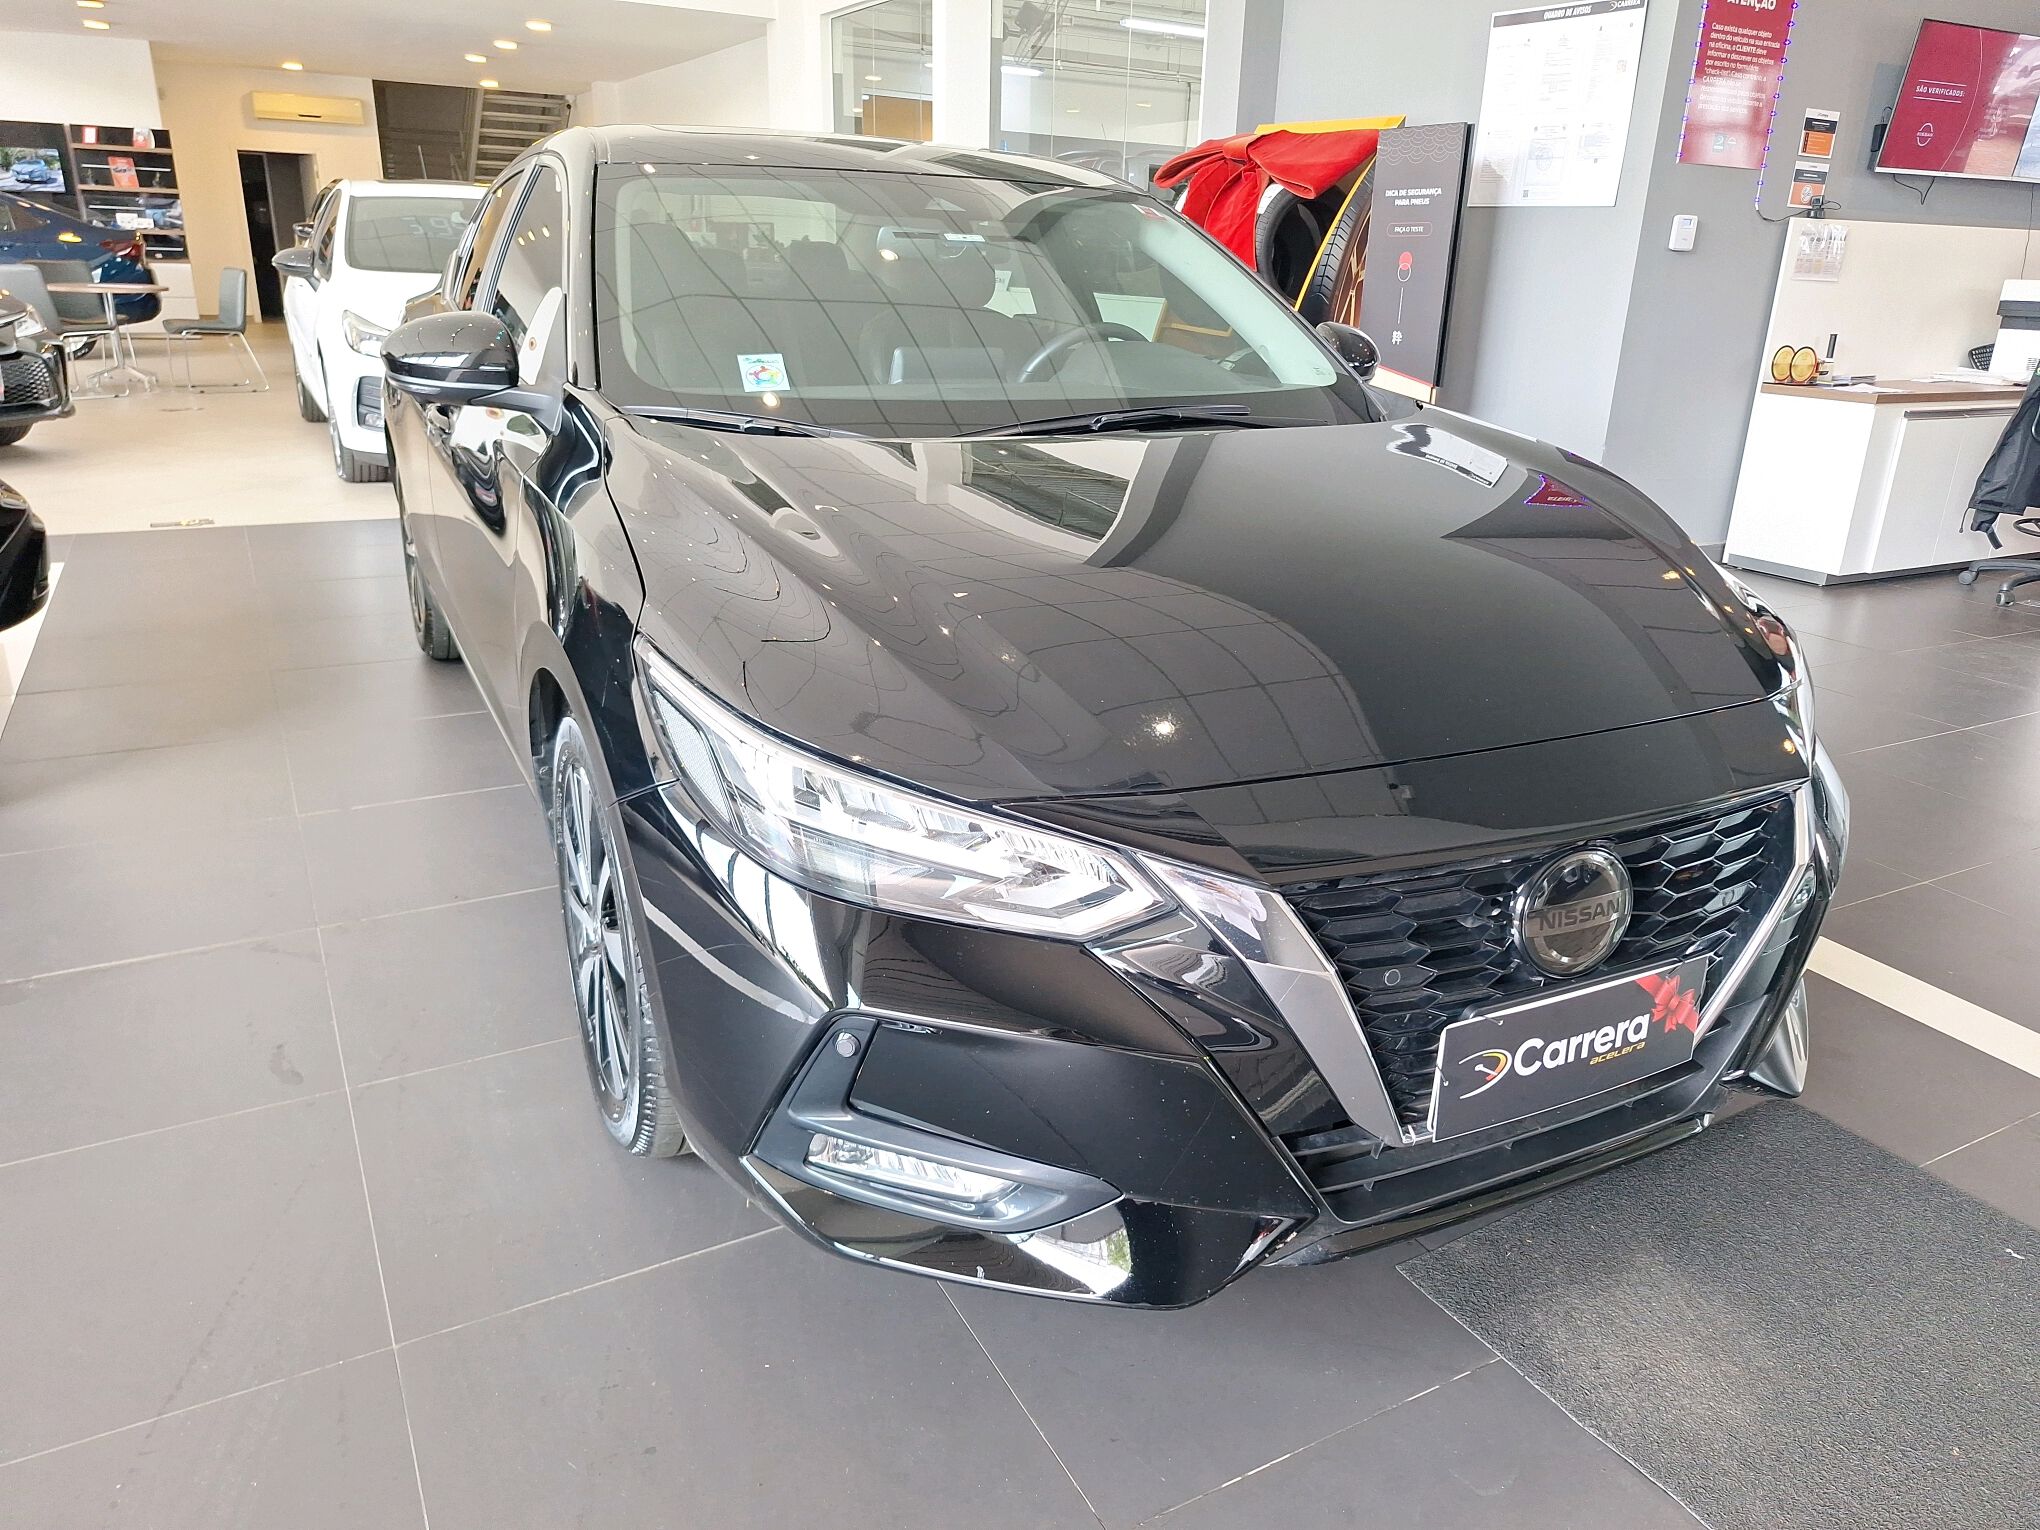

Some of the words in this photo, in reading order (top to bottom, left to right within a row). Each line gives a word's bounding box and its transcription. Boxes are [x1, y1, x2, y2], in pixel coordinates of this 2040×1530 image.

[1727, 0, 1776, 11] ENÇÃO
[1738, 27, 1758, 37] qualquer
[1758, 30, 1772, 39] objeto
[1736, 44, 1756, 53] CLIENTE
[1928, 88, 1965, 97] VERIFICADOS:
[1408, 188, 1442, 196] SEGURANÇA
[1540, 900, 1620, 931] NISSAN
[1513, 1014, 1650, 1076] Carrera
[1590, 1041, 1646, 1066] acelera
